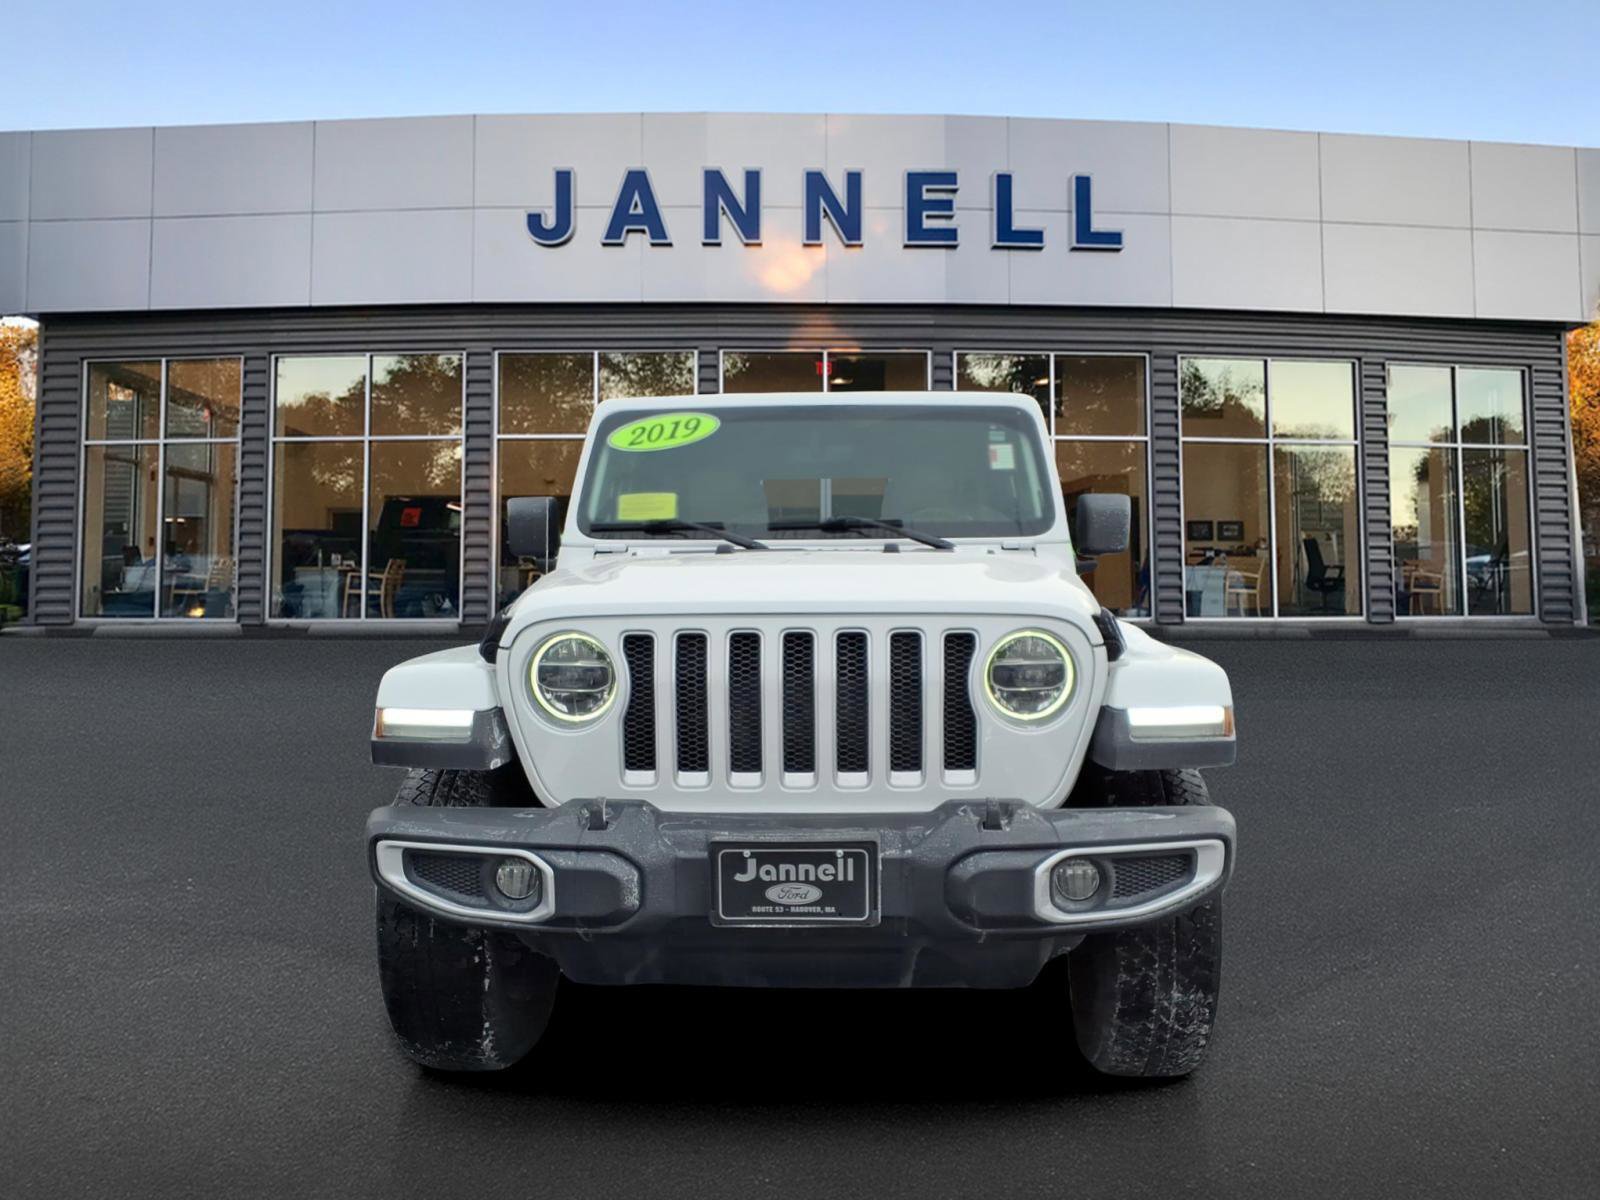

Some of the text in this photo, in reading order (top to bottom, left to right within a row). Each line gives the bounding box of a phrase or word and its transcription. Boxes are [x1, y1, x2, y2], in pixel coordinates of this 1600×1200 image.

[526, 166, 1123, 251] JANNELL
[628, 417, 701, 446] 2019
[733, 857, 854, 882] Jannell
[777, 886, 810, 900] Ford
